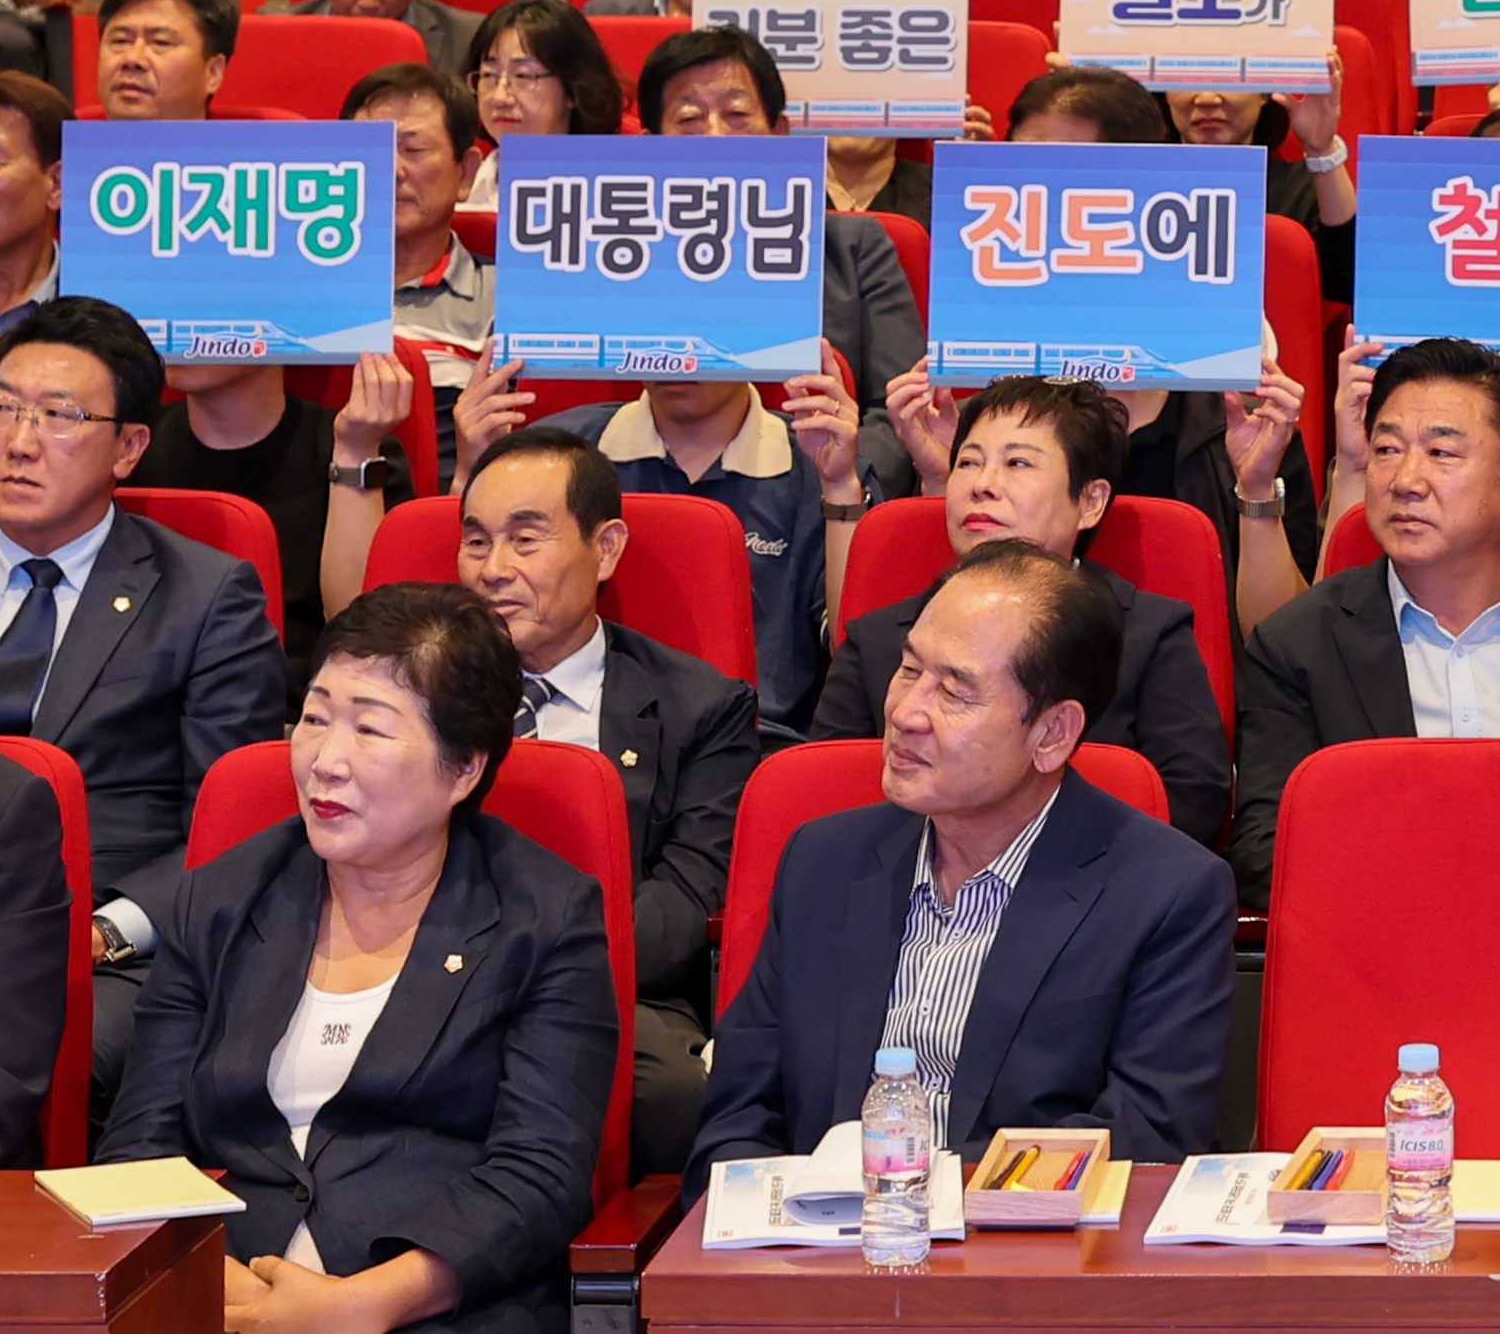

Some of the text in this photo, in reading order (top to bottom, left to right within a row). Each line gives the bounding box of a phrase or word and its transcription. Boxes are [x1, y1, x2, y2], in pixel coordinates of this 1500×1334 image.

[837, 7, 953, 67] 좋은
[96, 163, 364, 261] 이재명
[512, 178, 810, 278] 대통령님
[962, 185, 1232, 284] 진도에
[185, 334, 251, 358] Jindo
[617, 351, 683, 373] Jindo
